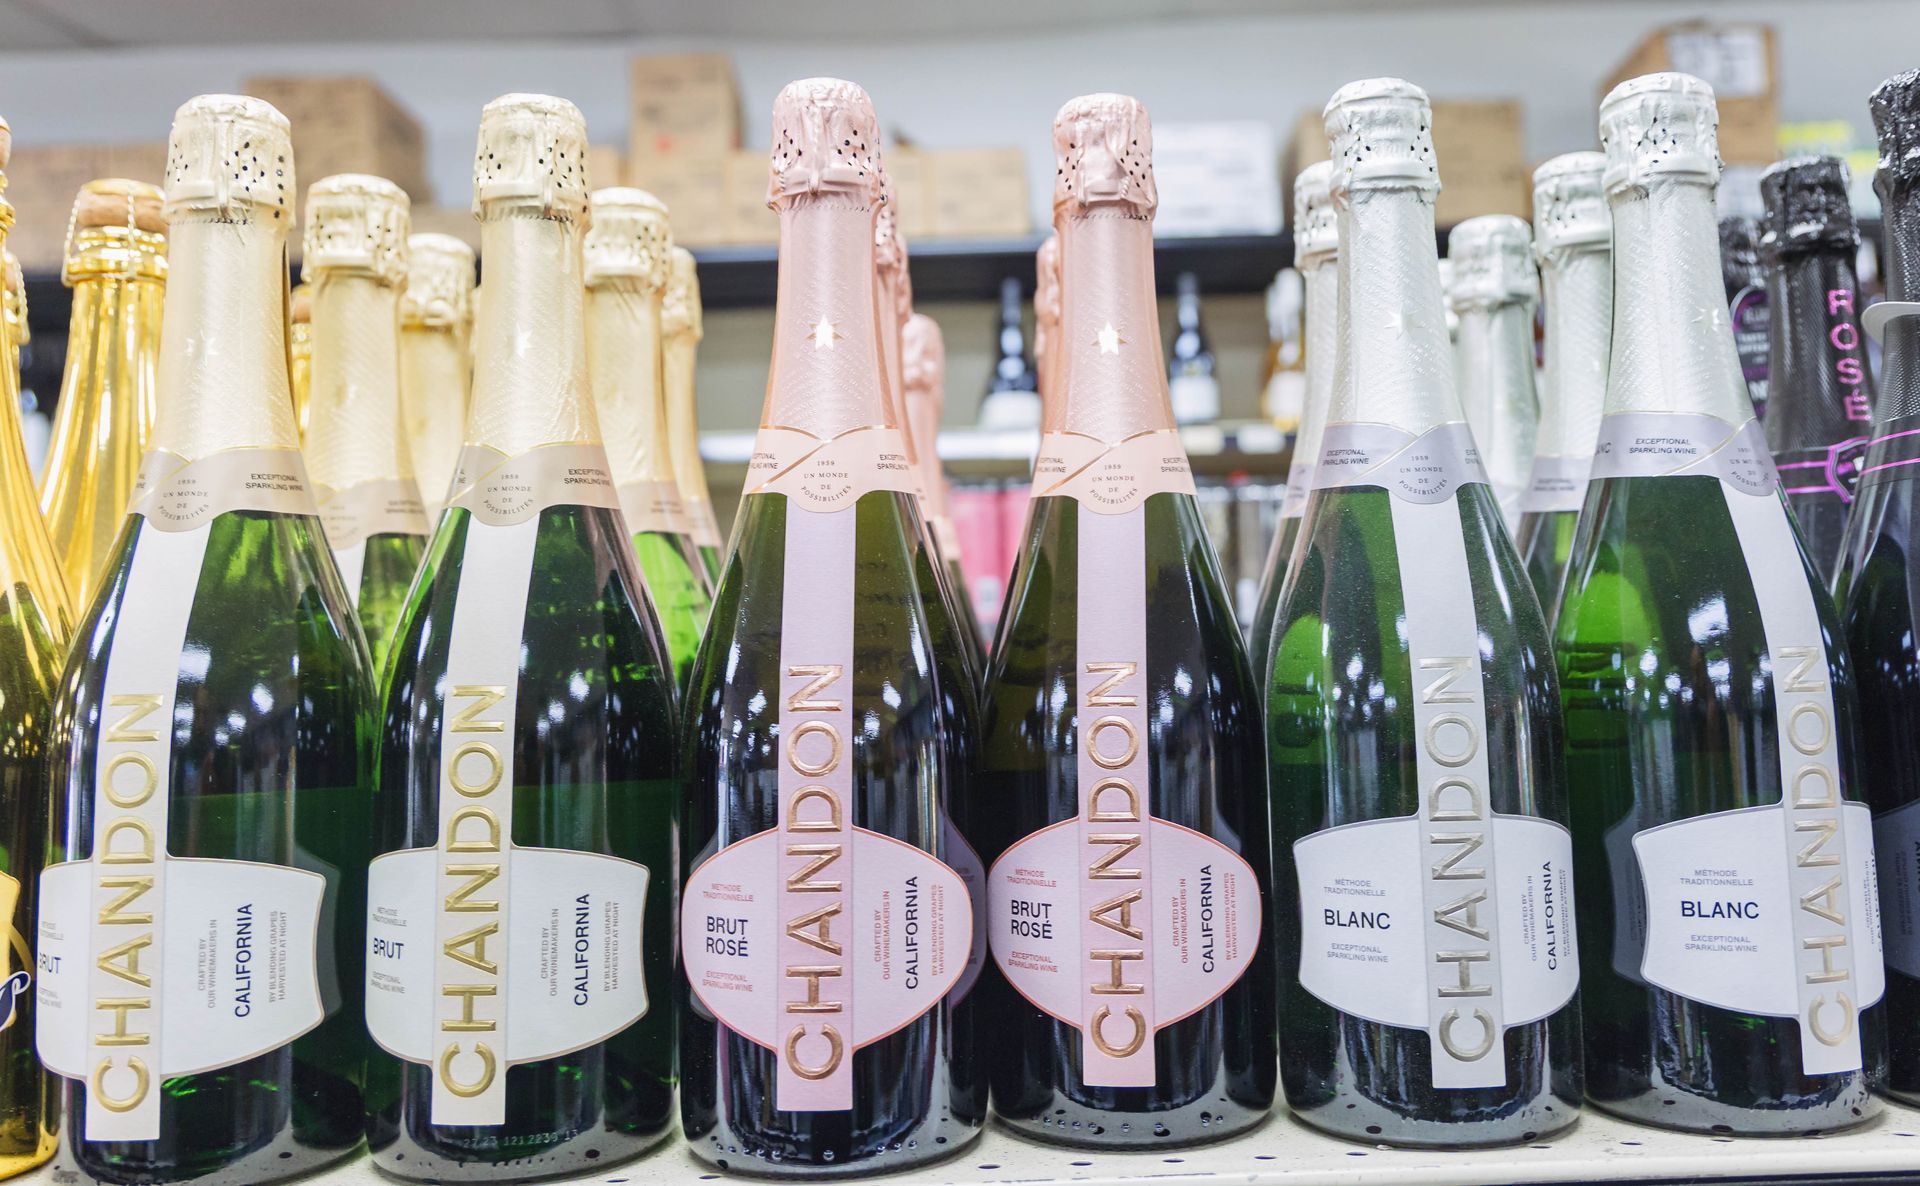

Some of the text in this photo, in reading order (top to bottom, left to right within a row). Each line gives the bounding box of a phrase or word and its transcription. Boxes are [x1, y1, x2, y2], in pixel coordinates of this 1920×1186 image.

[1634, 438, 1691, 446] EXCEPTIONAL
[1674, 447, 1697, 455] WINE
[1350, 457, 1370, 465] WINE
[245, 482, 287, 491] SPARKLING
[1779, 645, 1854, 1047] CHANDON
[1085, 661, 1147, 1058] CHANDON
[1419, 656, 1496, 1062] CHANDON
[785, 664, 843, 1080] CHANDON
[1007, 875, 1057, 888] TRADITIONNELLE
[1680, 877, 1754, 886] TRADITIONNELLE
[439, 685, 508, 1097] CHANDON
[883, 890, 890, 899] IN
[1172, 896, 1179, 906] BY
[1323, 886, 1386, 897] TRADITIONNELLE
[93, 694, 164, 1113] CHANDON
[552, 908, 559, 918] IN
[1011, 899, 1052, 919] BRUT
[1681, 900, 1760, 919] BLANC
[706, 915, 748, 935] BRUT
[874, 909, 881, 921] BY
[1179, 878, 1189, 964] OUR WINEMAKERS IN
[1200, 864, 1215, 974] CALIFORNIA
[1324, 908, 1391, 930] BLANC
[1543, 861, 1557, 970] CALIFORNIA
[270, 910, 278, 945] GRAPES
[612, 929, 619, 939] AT
[905, 876, 919, 990] CALIFORNIA
[1011, 919, 1053, 939] ROSÉ
[279, 939, 287, 948] AT
[373, 937, 404, 960] BRUT
[706, 937, 748, 957] ROSÉ
[1331, 942, 1382, 954] EXCEPTIONAL
[1684, 943, 1758, 953] SPARKLING WINE
[1690, 934, 1751, 943] EXCEPTIONAL
[234, 903, 252, 1017] CALIFORNIA
[540, 927, 549, 979] CRAFTED BY
[574, 894, 590, 1006] CALIFORNIA
[1011, 951, 1053, 963] EXCEPTIONAL
[1327, 951, 1389, 963] SPARKLING WINE
[198, 938, 207, 991] CRAFTED BY
[208, 919, 217, 1009] OUR WINEMAKERS IN
[269, 947, 277, 990] BLENDING
[1008, 958, 1058, 973] SPARKLING WINE
[278, 950, 287, 1000] HARVESTED
[735, 983, 753, 992] WINE
